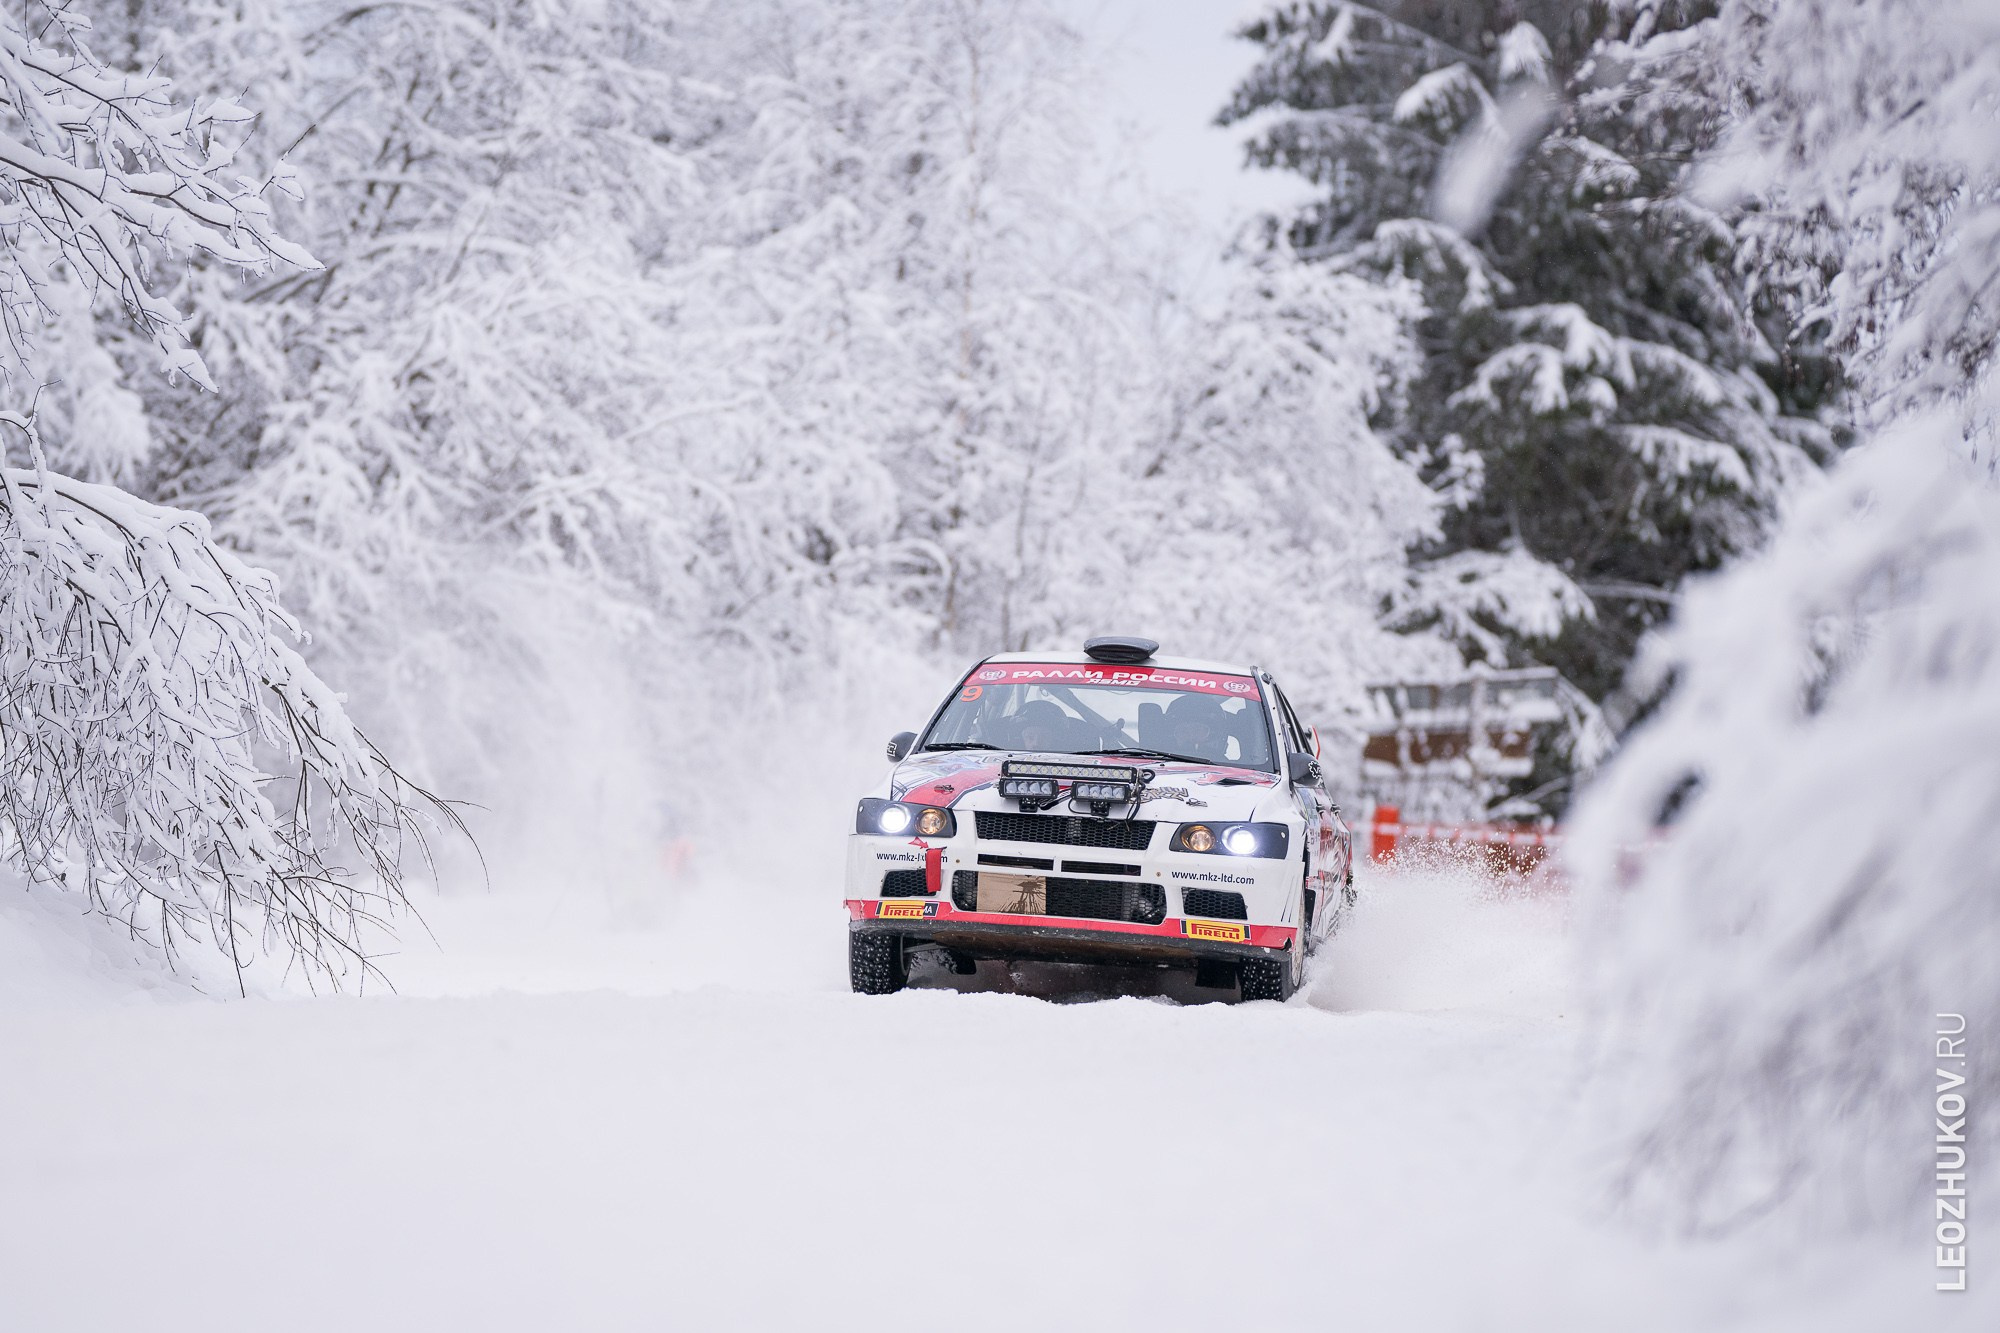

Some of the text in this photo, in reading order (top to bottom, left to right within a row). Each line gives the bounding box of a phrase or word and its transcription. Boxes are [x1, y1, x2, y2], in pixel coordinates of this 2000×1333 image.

[1011, 670, 1103, 680] РАЛЛИ
[1112, 671, 1217, 689] РОССИИ
[960, 685, 984, 702] 9
[1171, 870, 1255, 885] www.mkz-ltd.com
[883, 904, 924, 917] PIRELL
[1191, 923, 1240, 940] PIRELLI
